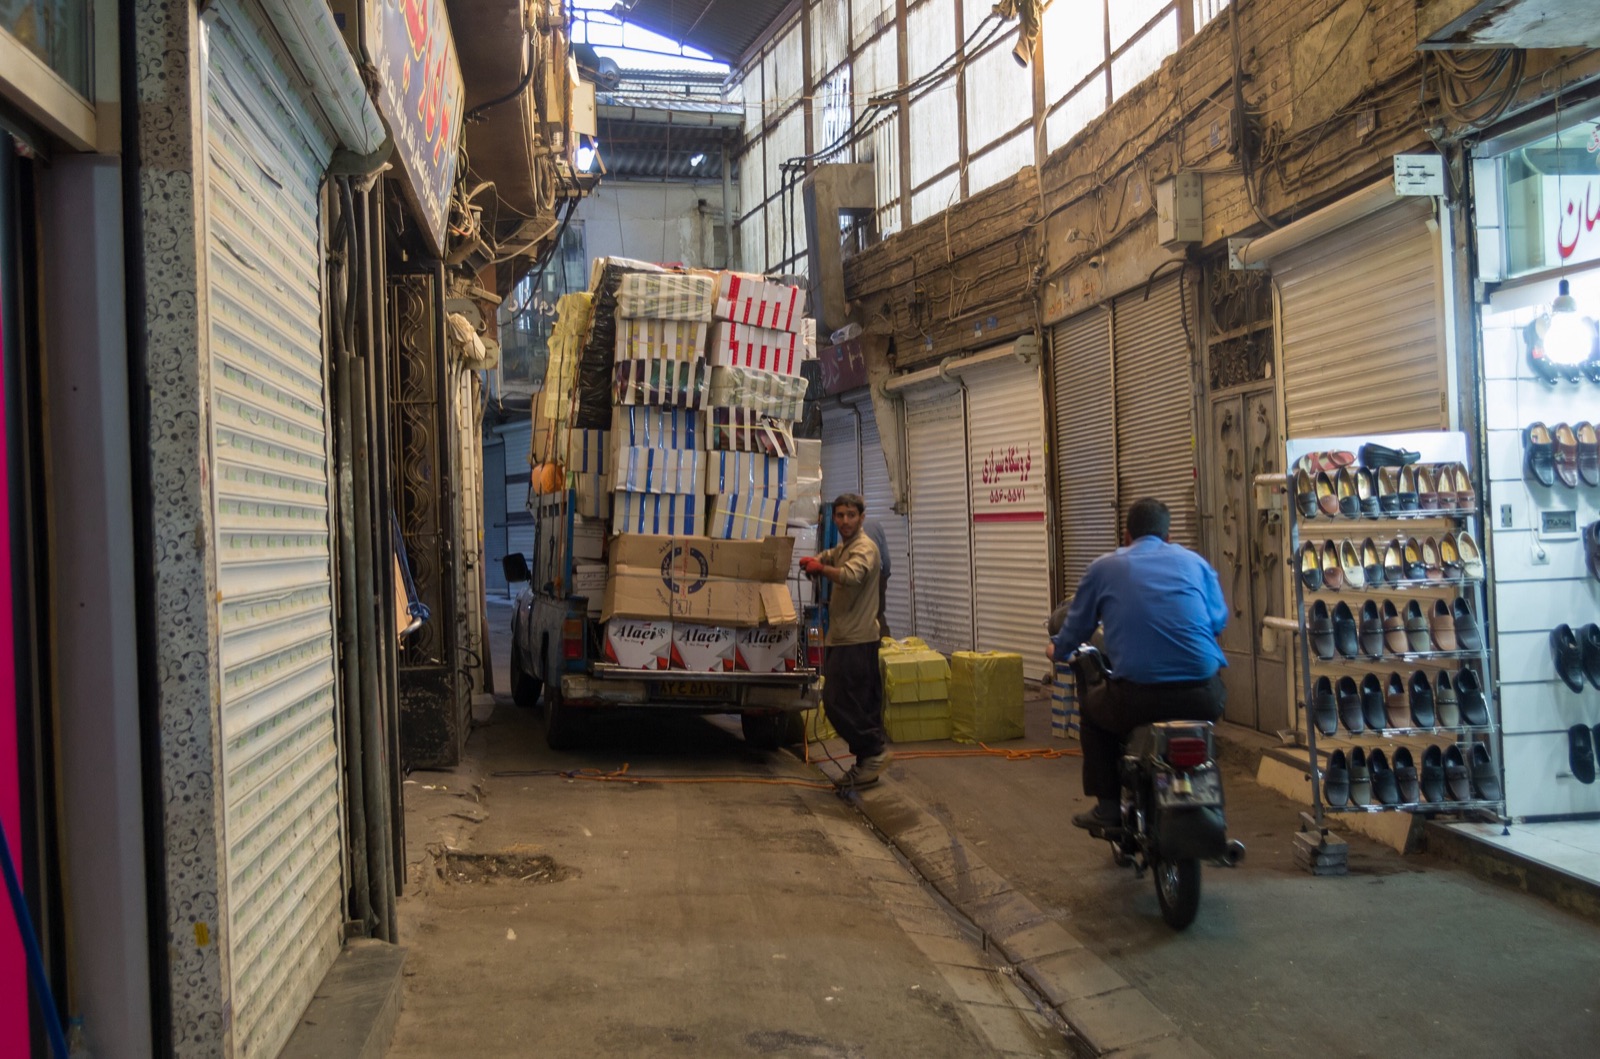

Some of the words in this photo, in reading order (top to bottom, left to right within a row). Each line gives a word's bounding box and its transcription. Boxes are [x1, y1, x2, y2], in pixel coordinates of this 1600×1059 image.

[982, 447, 1004, 484] شیرازی
[1005, 441, 1031, 481] فروشگاه
[613, 623, 656, 640] Alaei
[679, 628, 721, 643] Alaei
[741, 629, 783, 644] Alaei
